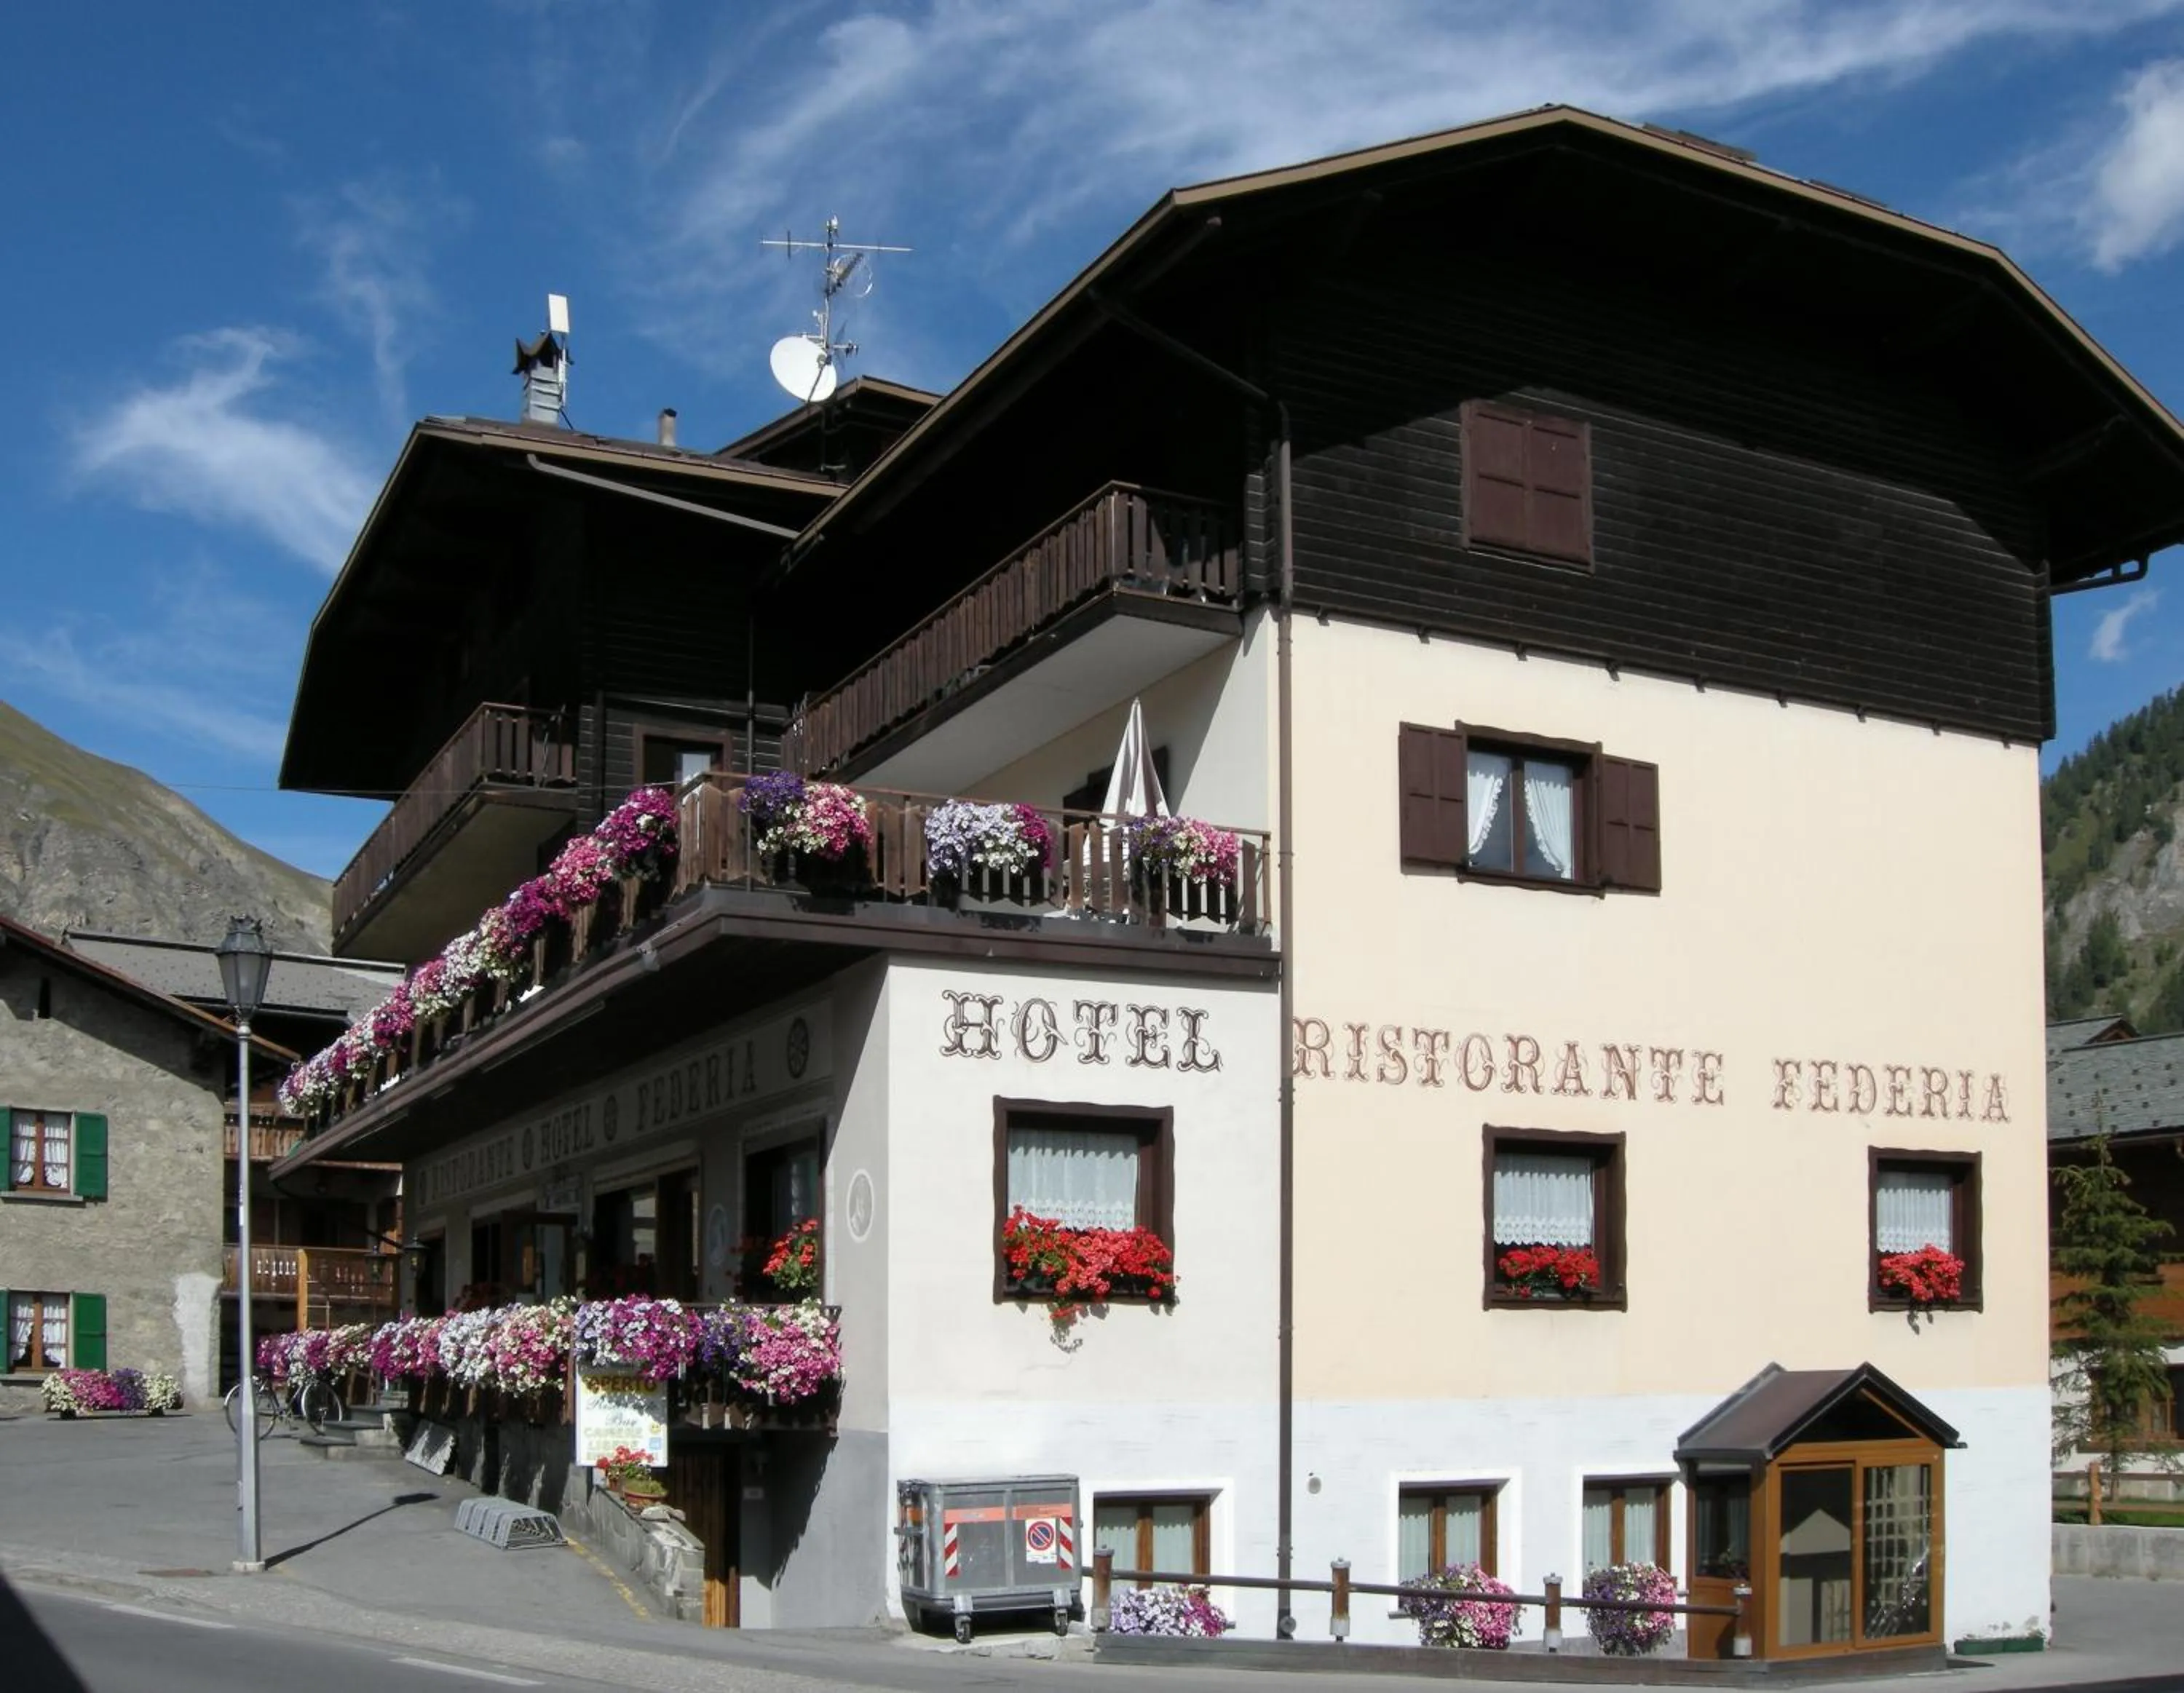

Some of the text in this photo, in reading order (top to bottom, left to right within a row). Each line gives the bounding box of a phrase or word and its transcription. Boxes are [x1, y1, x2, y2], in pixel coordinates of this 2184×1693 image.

[432, 1040, 757, 1200] RISTORANTE HOTEL FEDERIA
[939, 989, 2011, 1123] HOTEL RISTORANTE FEDERIA
